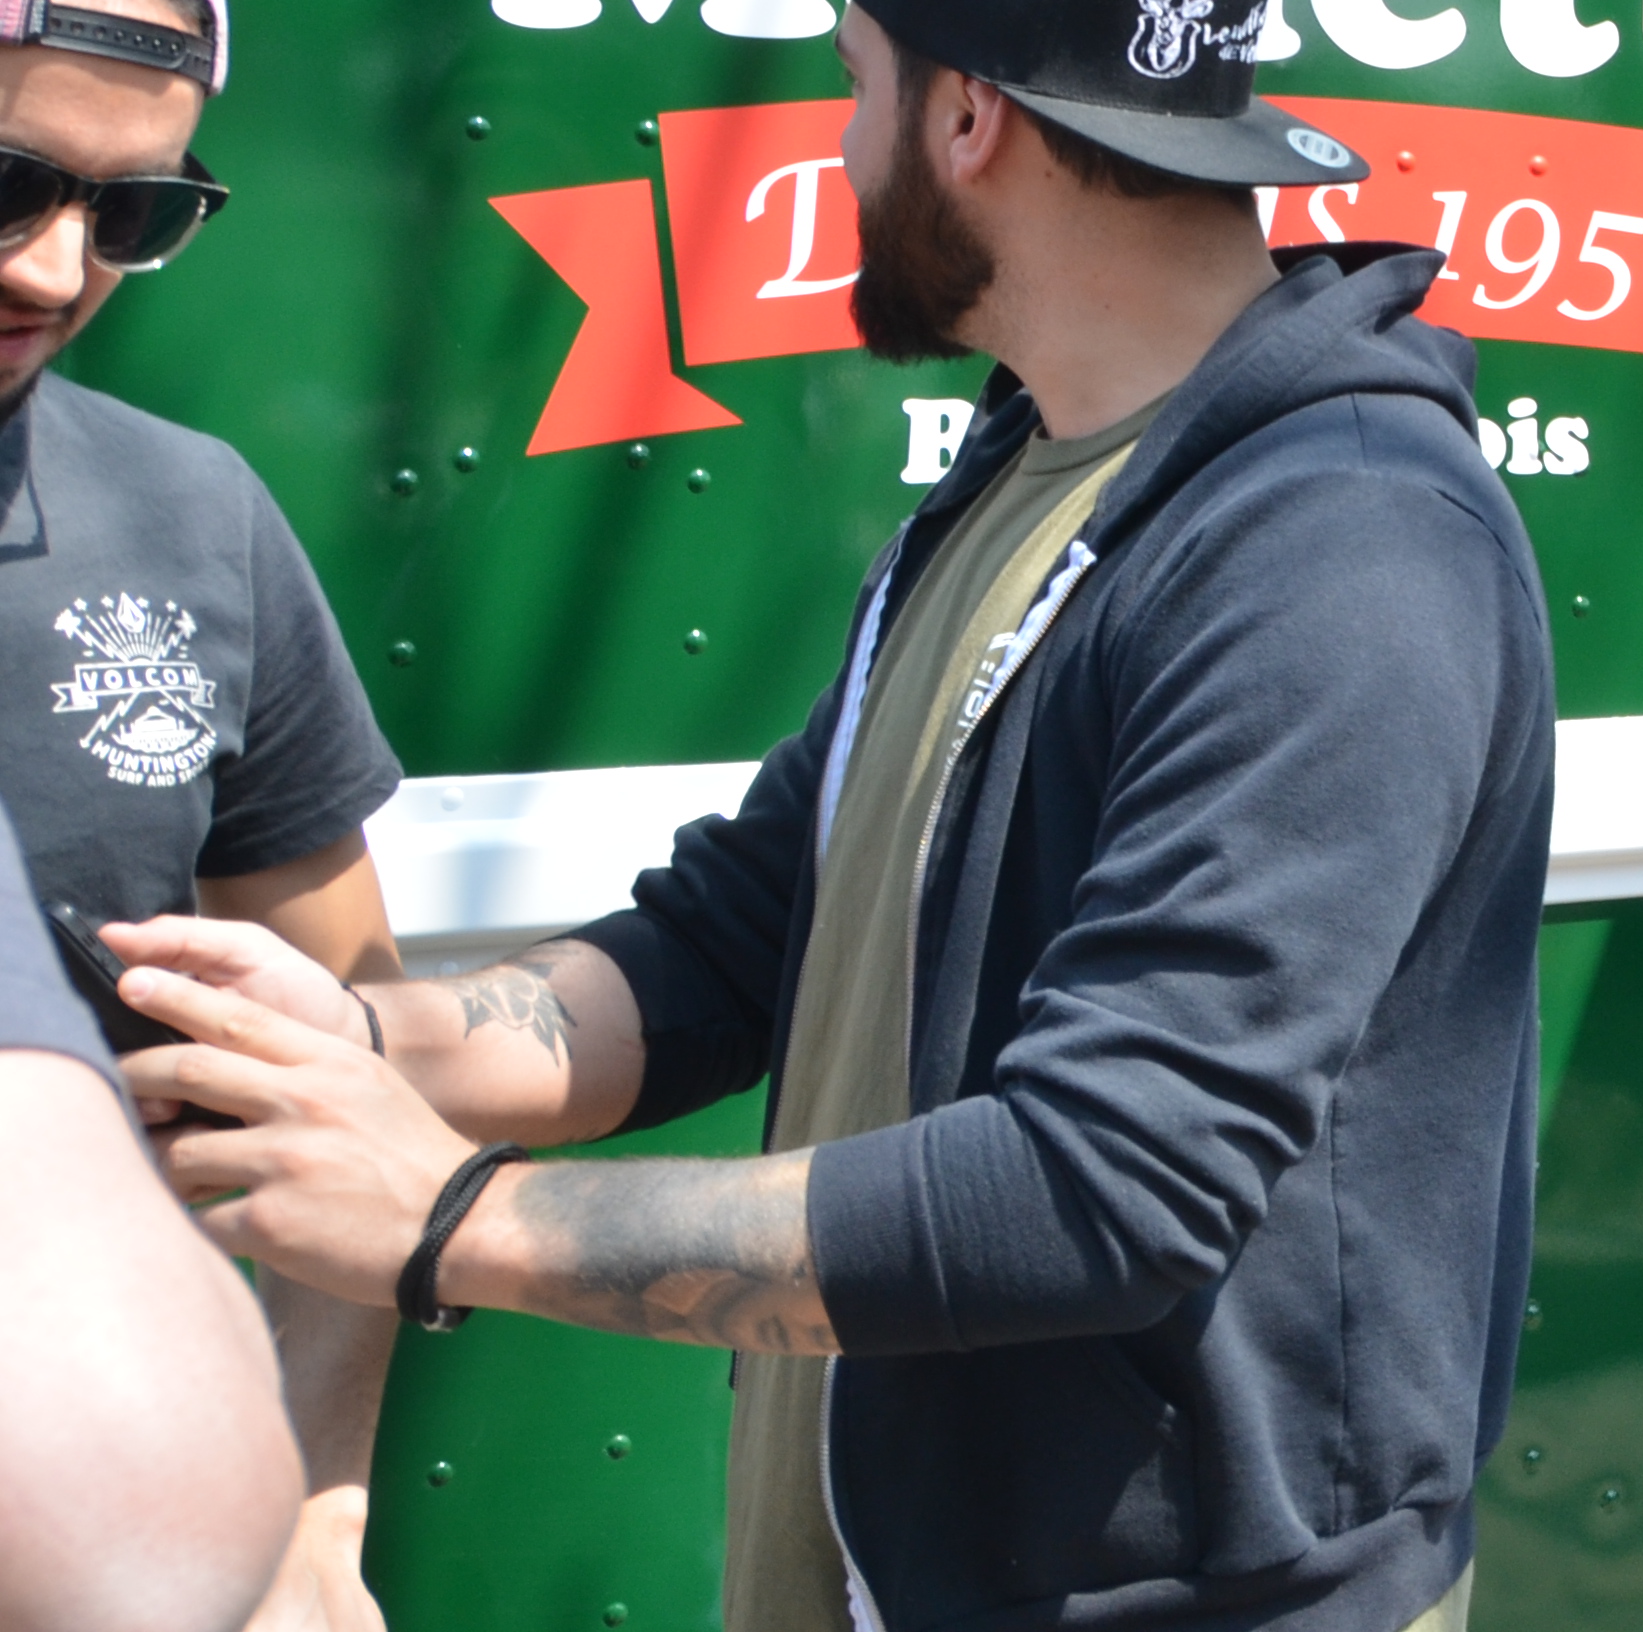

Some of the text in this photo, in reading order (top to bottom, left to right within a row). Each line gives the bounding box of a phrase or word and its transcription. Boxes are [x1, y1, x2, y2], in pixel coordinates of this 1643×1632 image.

[82, 668, 199, 691] VOLCOM
[90, 731, 218, 774] HUNTINGTON
[147, 773, 177, 787] AND
